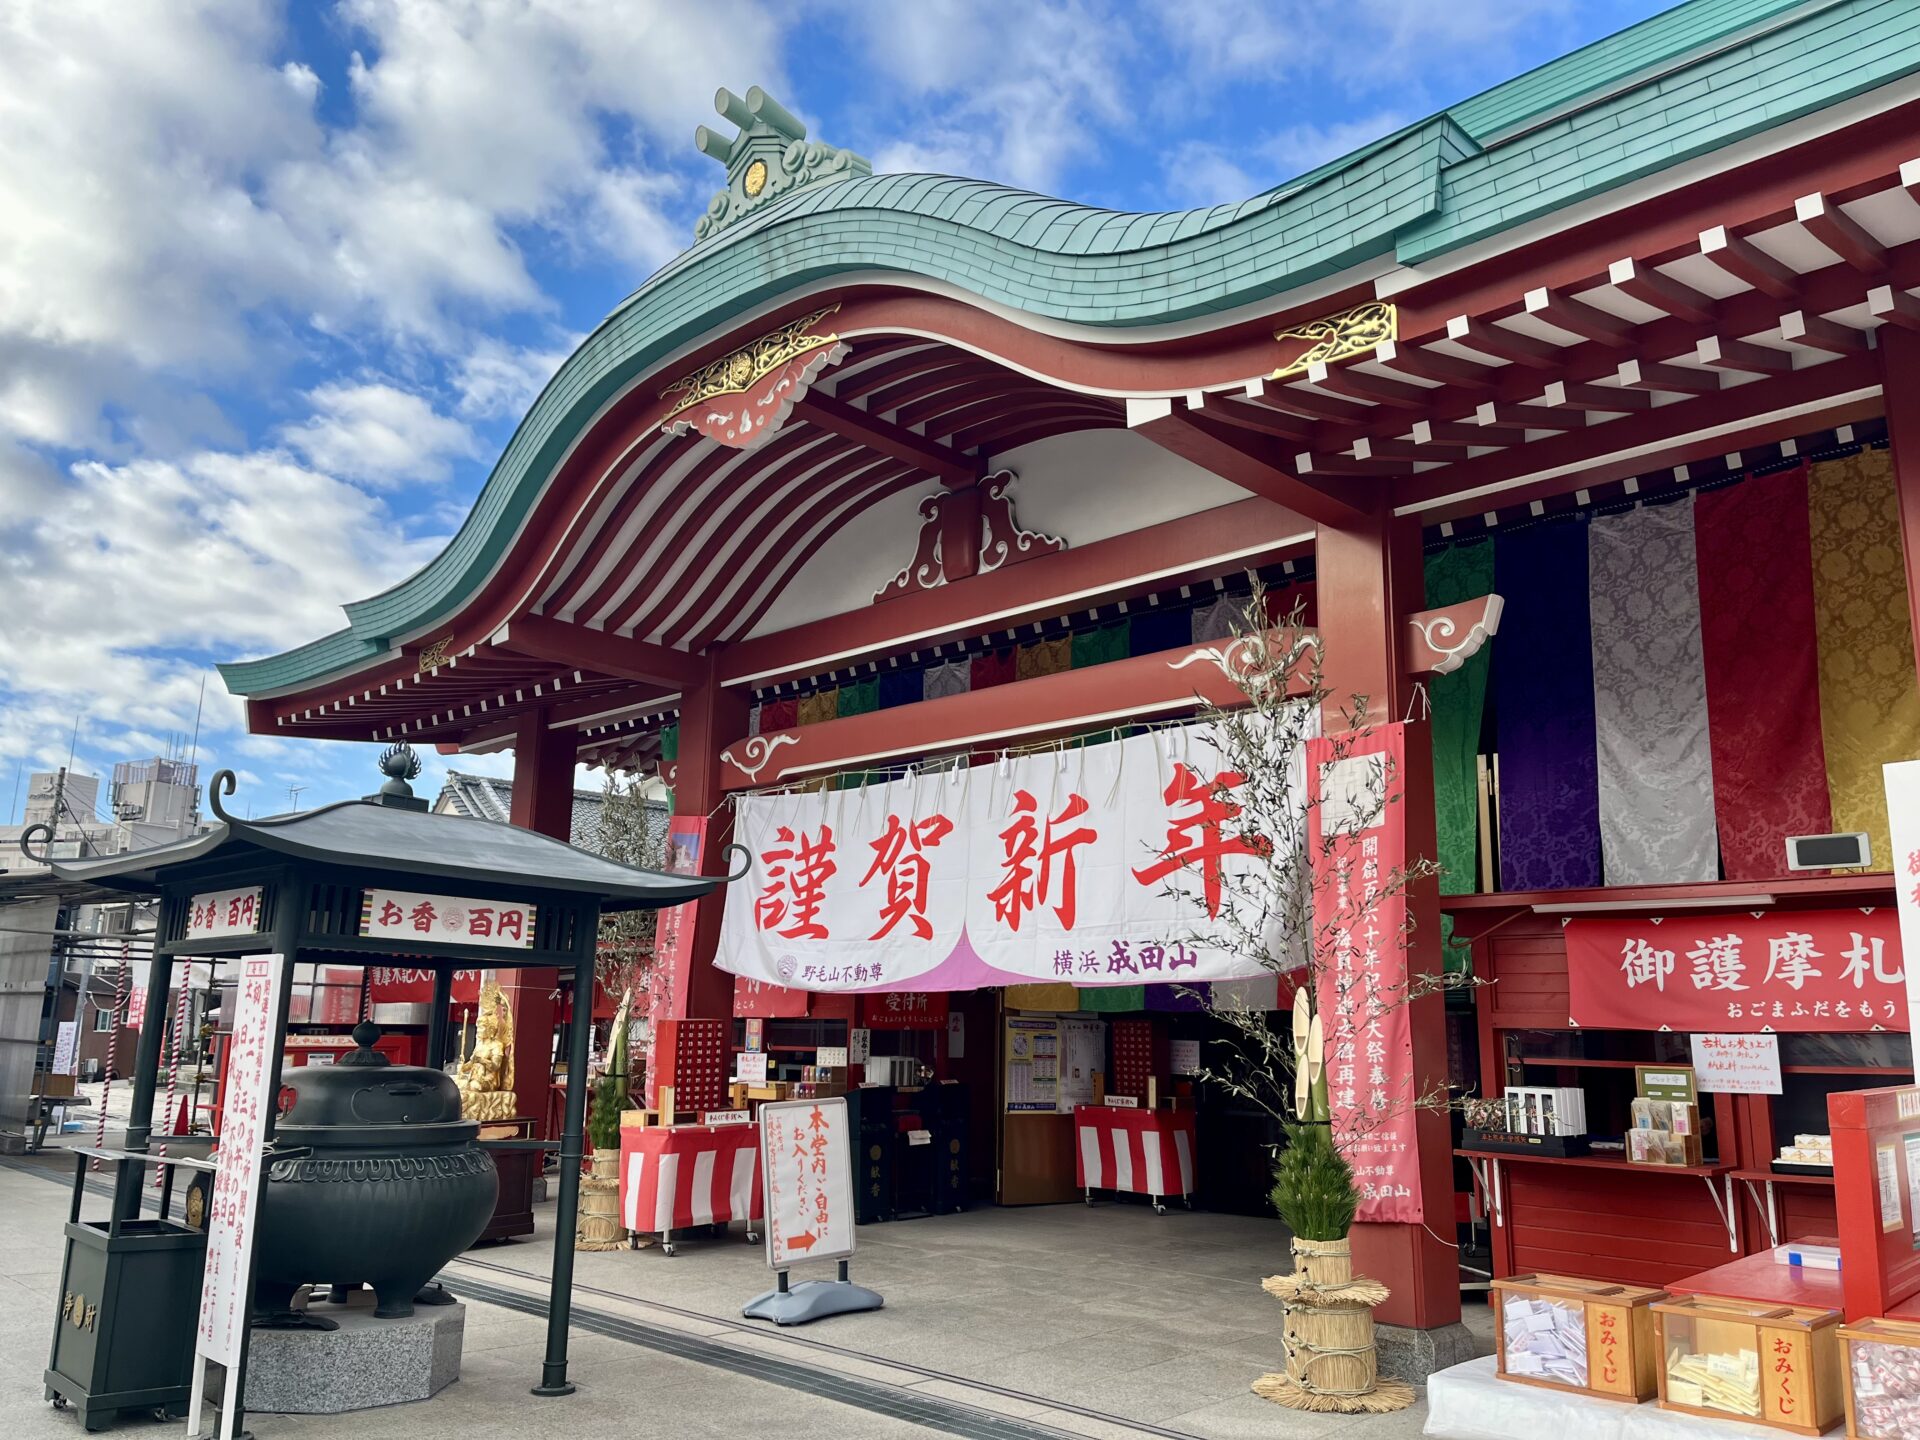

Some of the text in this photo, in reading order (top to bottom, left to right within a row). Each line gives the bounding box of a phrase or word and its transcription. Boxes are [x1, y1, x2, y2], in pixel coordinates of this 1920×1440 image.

[754, 762, 1273, 940] 謹賀新年
[193, 895, 255, 930] お香 百円
[378, 900, 524, 940] お香 百円
[801, 962, 883, 983] 野毛山不動尊
[1619, 930, 1905, 993] 御護摩札
[1727, 1000, 1896, 1019] おごまふだをもう
[792, 1127, 809, 1216] お入りください
[808, 1104, 829, 1239] 本堂内ご自由に
[1363, 1183, 1411, 1200] 成田山
[1599, 1311, 1617, 1384] おみくじ
[1774, 1337, 1794, 1415] おみくじ
